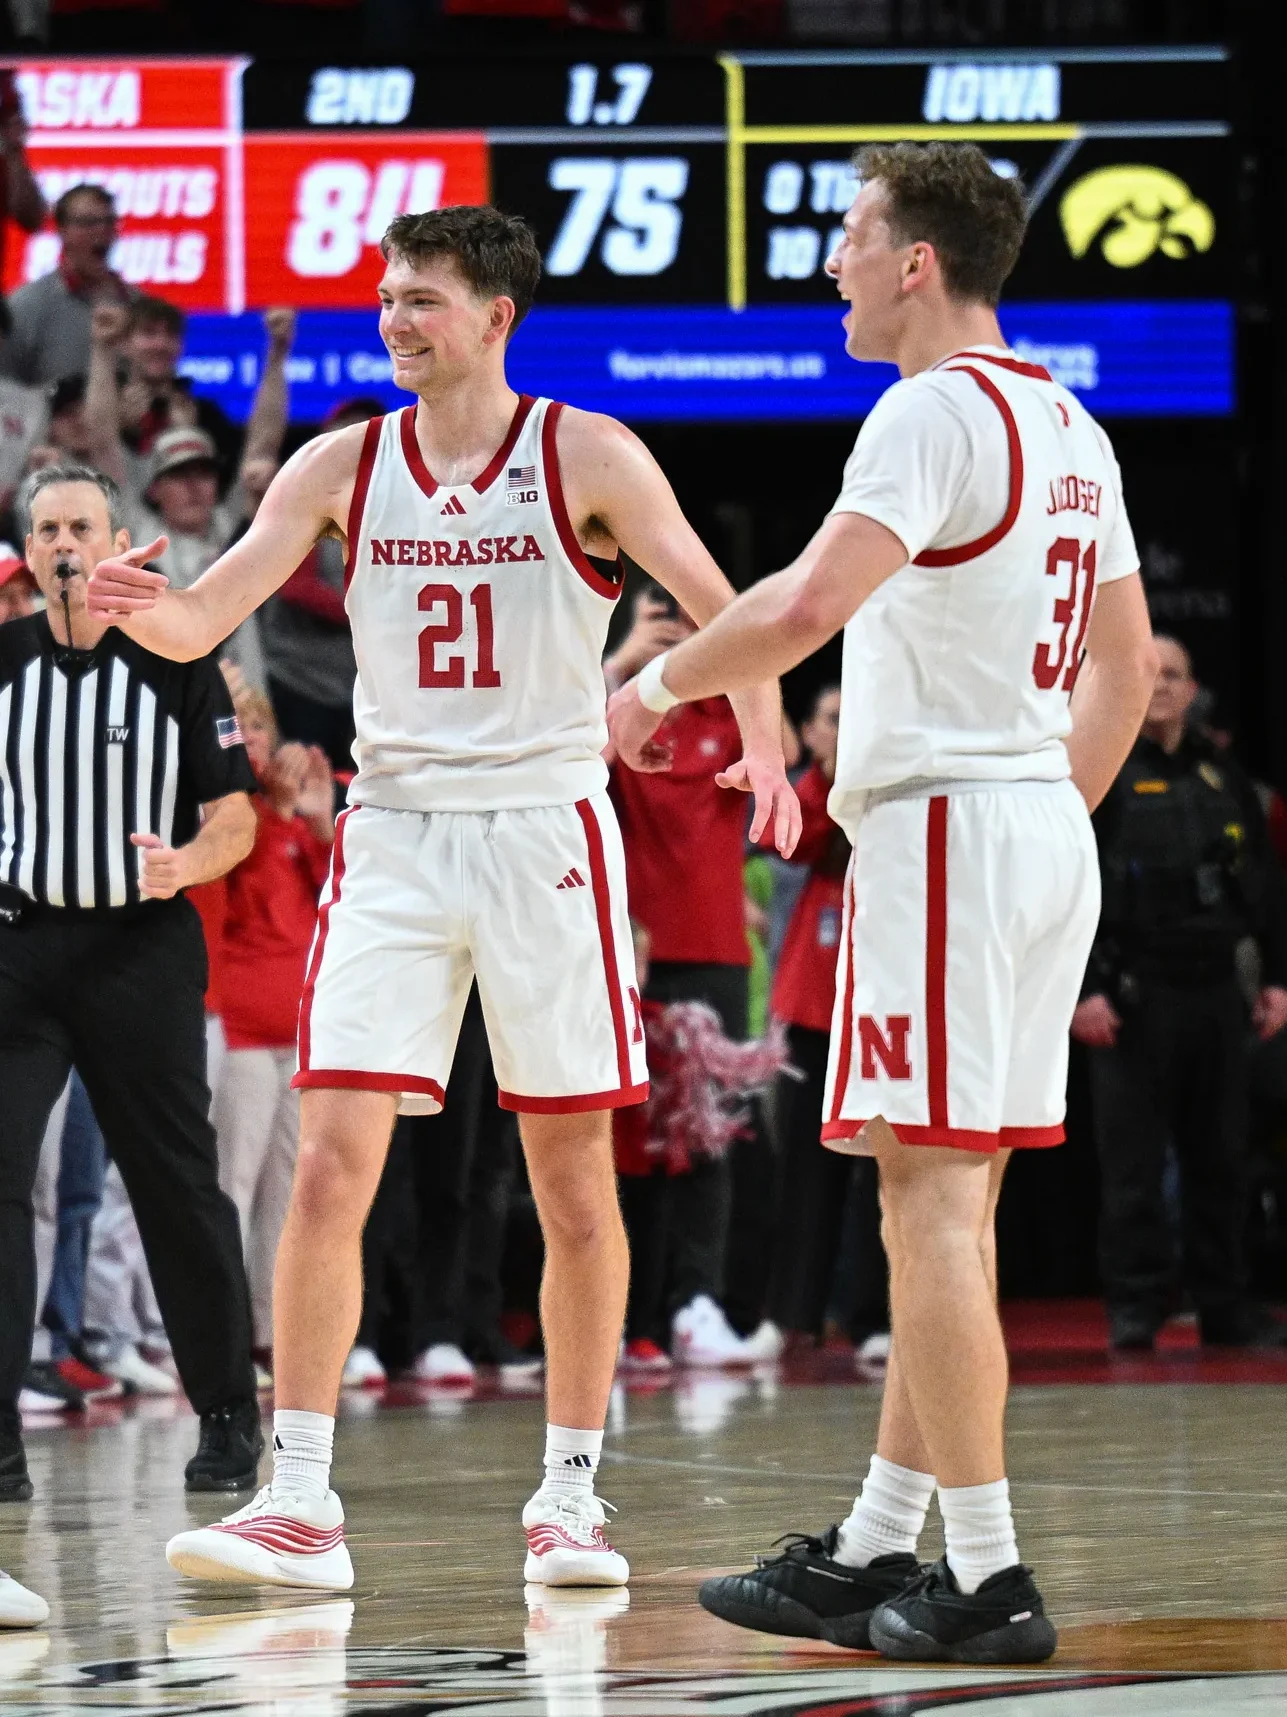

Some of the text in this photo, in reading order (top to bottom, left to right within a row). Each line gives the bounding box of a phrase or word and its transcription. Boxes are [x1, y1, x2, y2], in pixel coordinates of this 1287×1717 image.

[306, 67, 416, 124] 2ND
[566, 63, 653, 125] 1.7
[923, 63, 1062, 122] IOWA
[545, 157, 690, 276] 75
[768, 226, 821, 279] 10
[371, 535, 546, 566] NEBRASKA
[417, 583, 502, 688] 21
[1031, 535, 1097, 692] 31
[106, 728, 129, 741] TW
[858, 1013, 913, 1081] N
